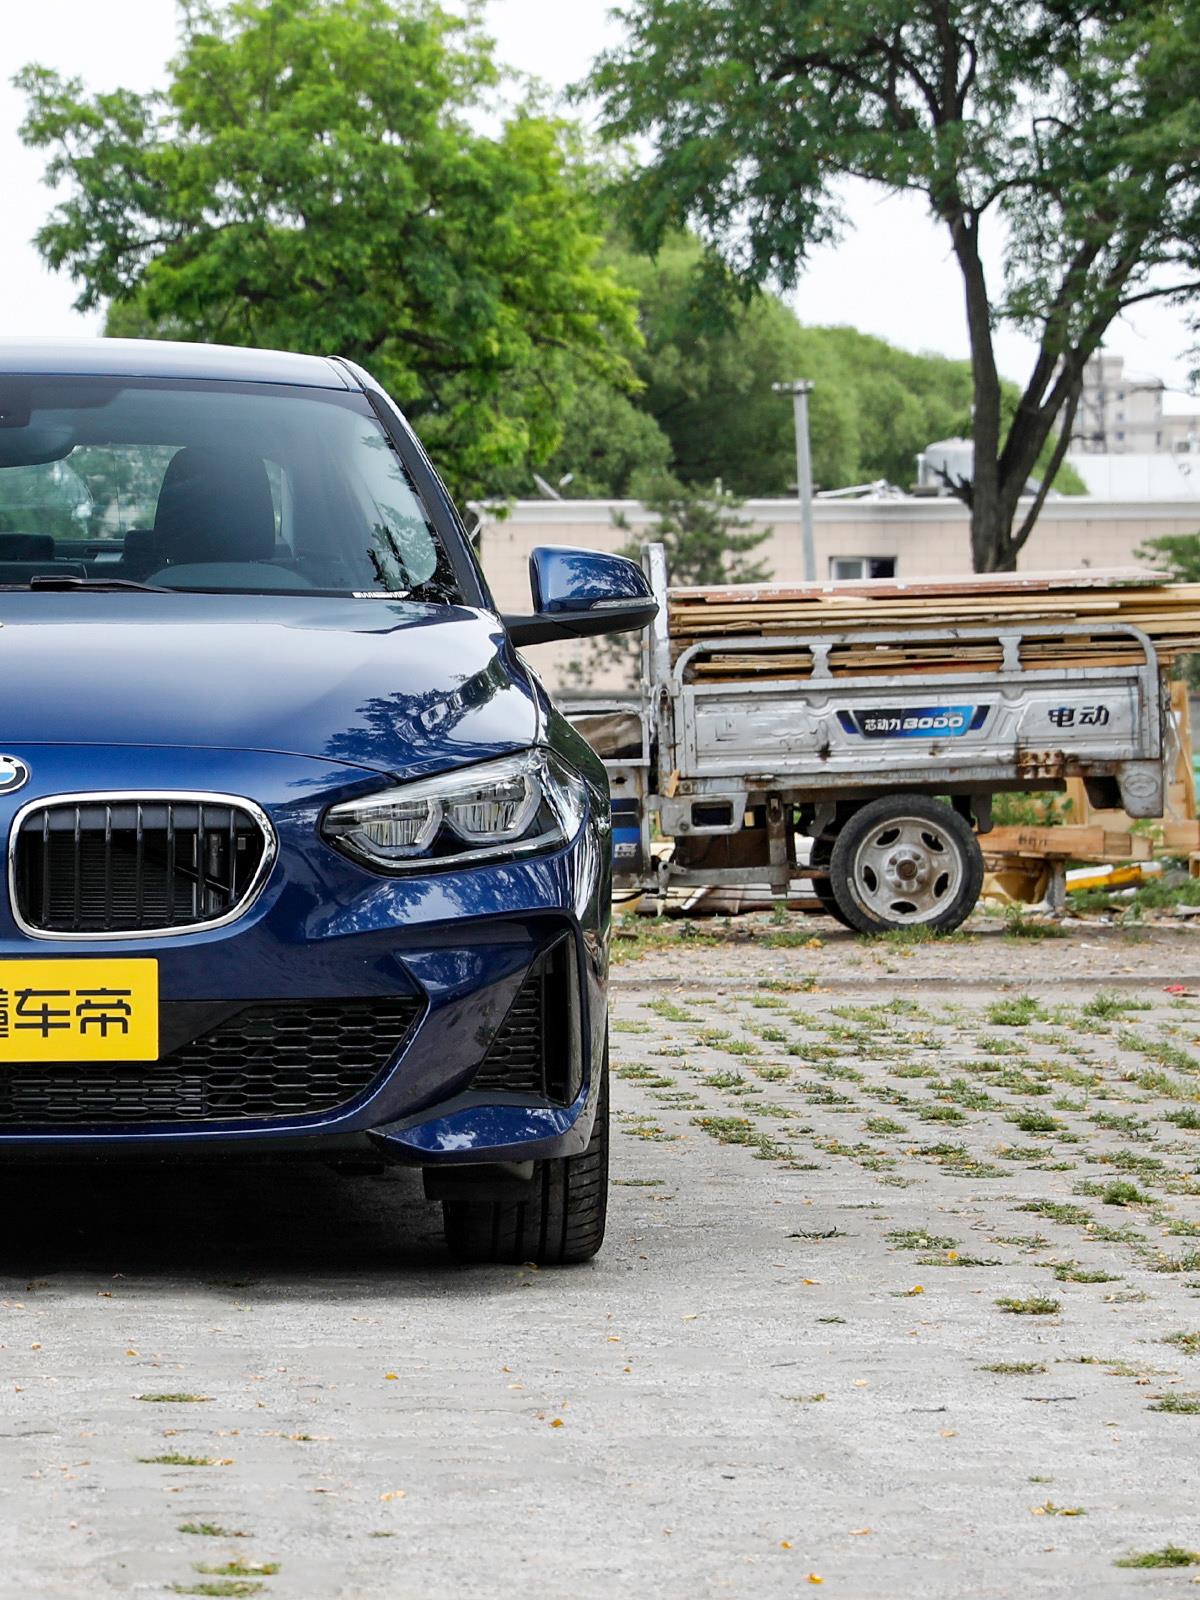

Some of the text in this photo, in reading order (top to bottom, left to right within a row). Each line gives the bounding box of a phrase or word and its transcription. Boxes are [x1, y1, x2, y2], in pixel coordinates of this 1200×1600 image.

[864, 718, 901, 731] 芯动力
[1047, 704, 1110, 728] 电动
